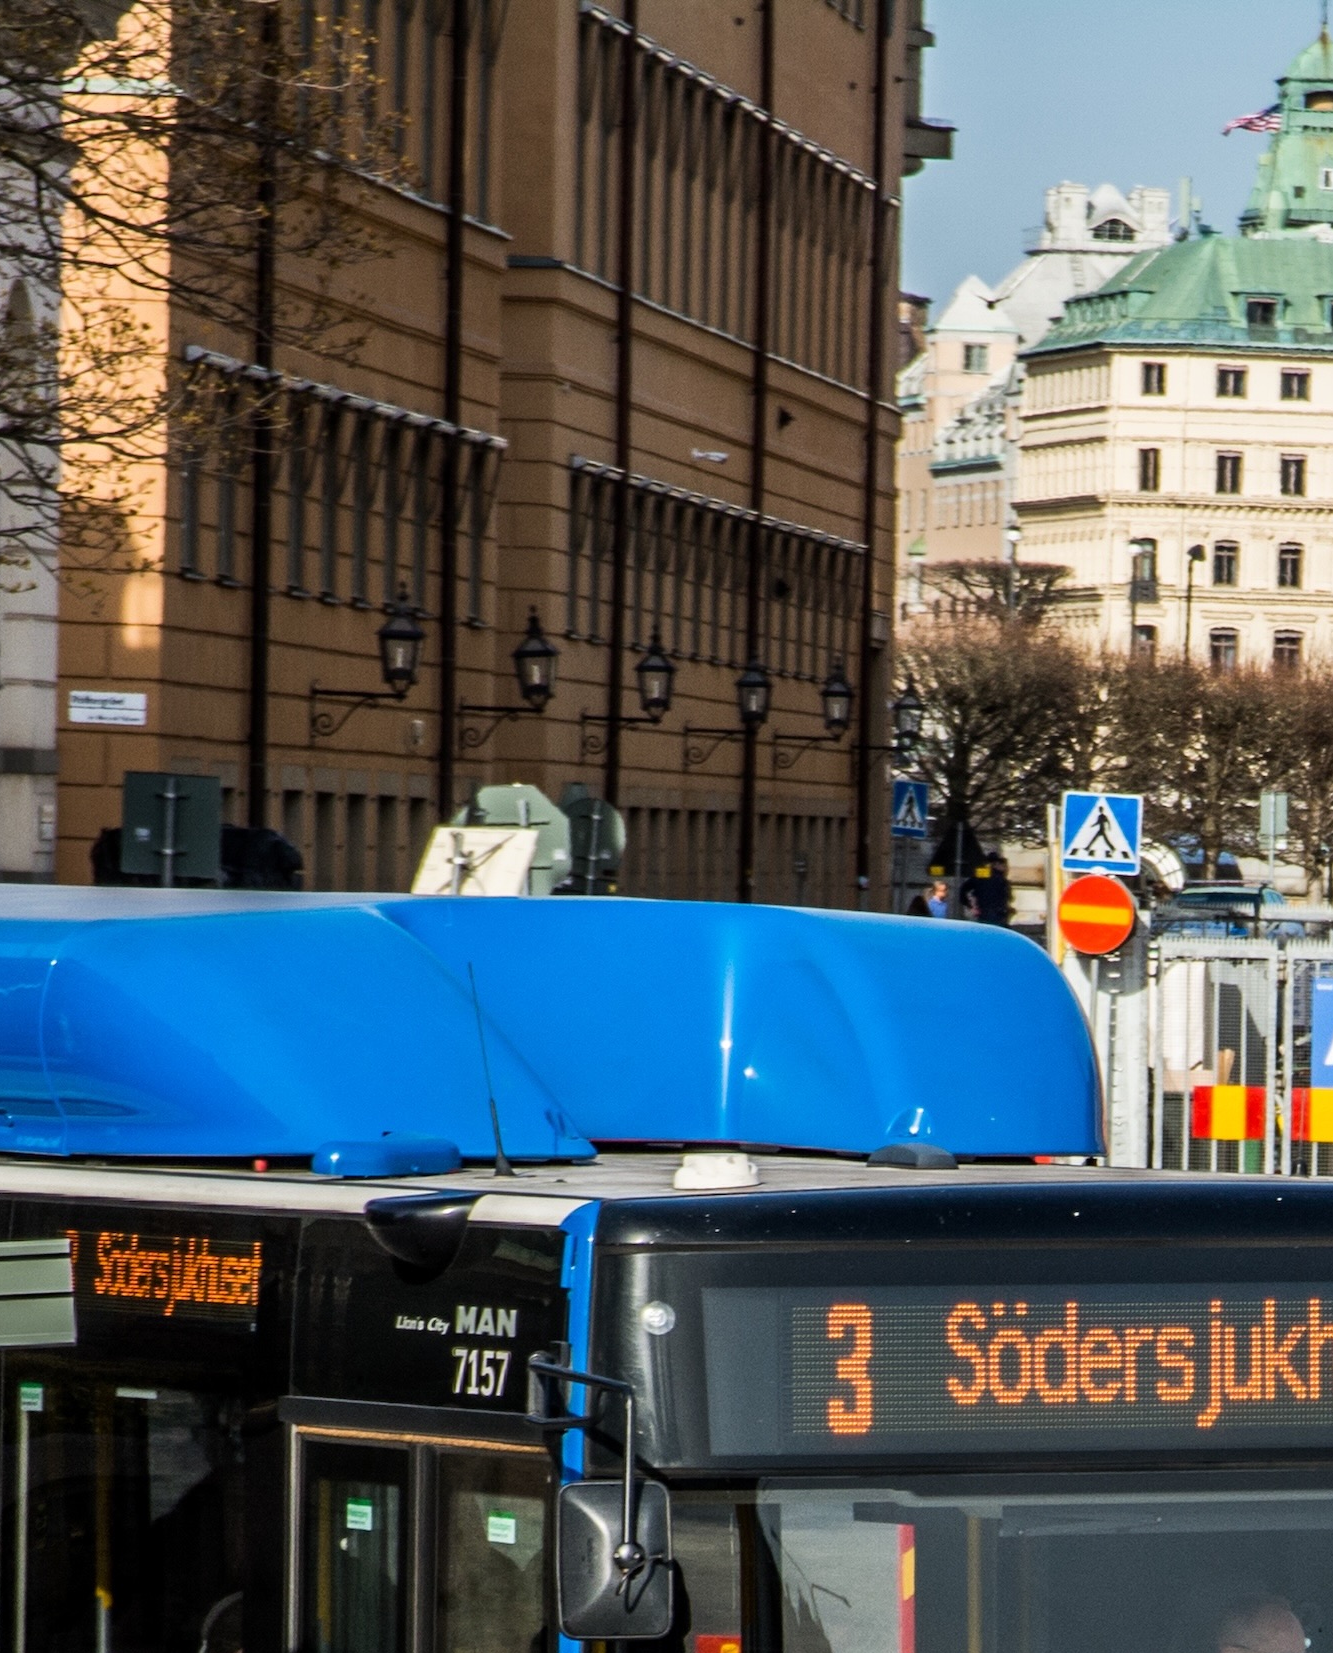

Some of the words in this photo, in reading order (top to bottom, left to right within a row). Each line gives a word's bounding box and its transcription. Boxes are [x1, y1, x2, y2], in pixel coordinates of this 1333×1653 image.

[427, 1317, 450, 1335] City
[455, 1305, 518, 1338] MAN
[452, 1347, 512, 1397] 7157
[826, 1302, 873, 1434] 3
